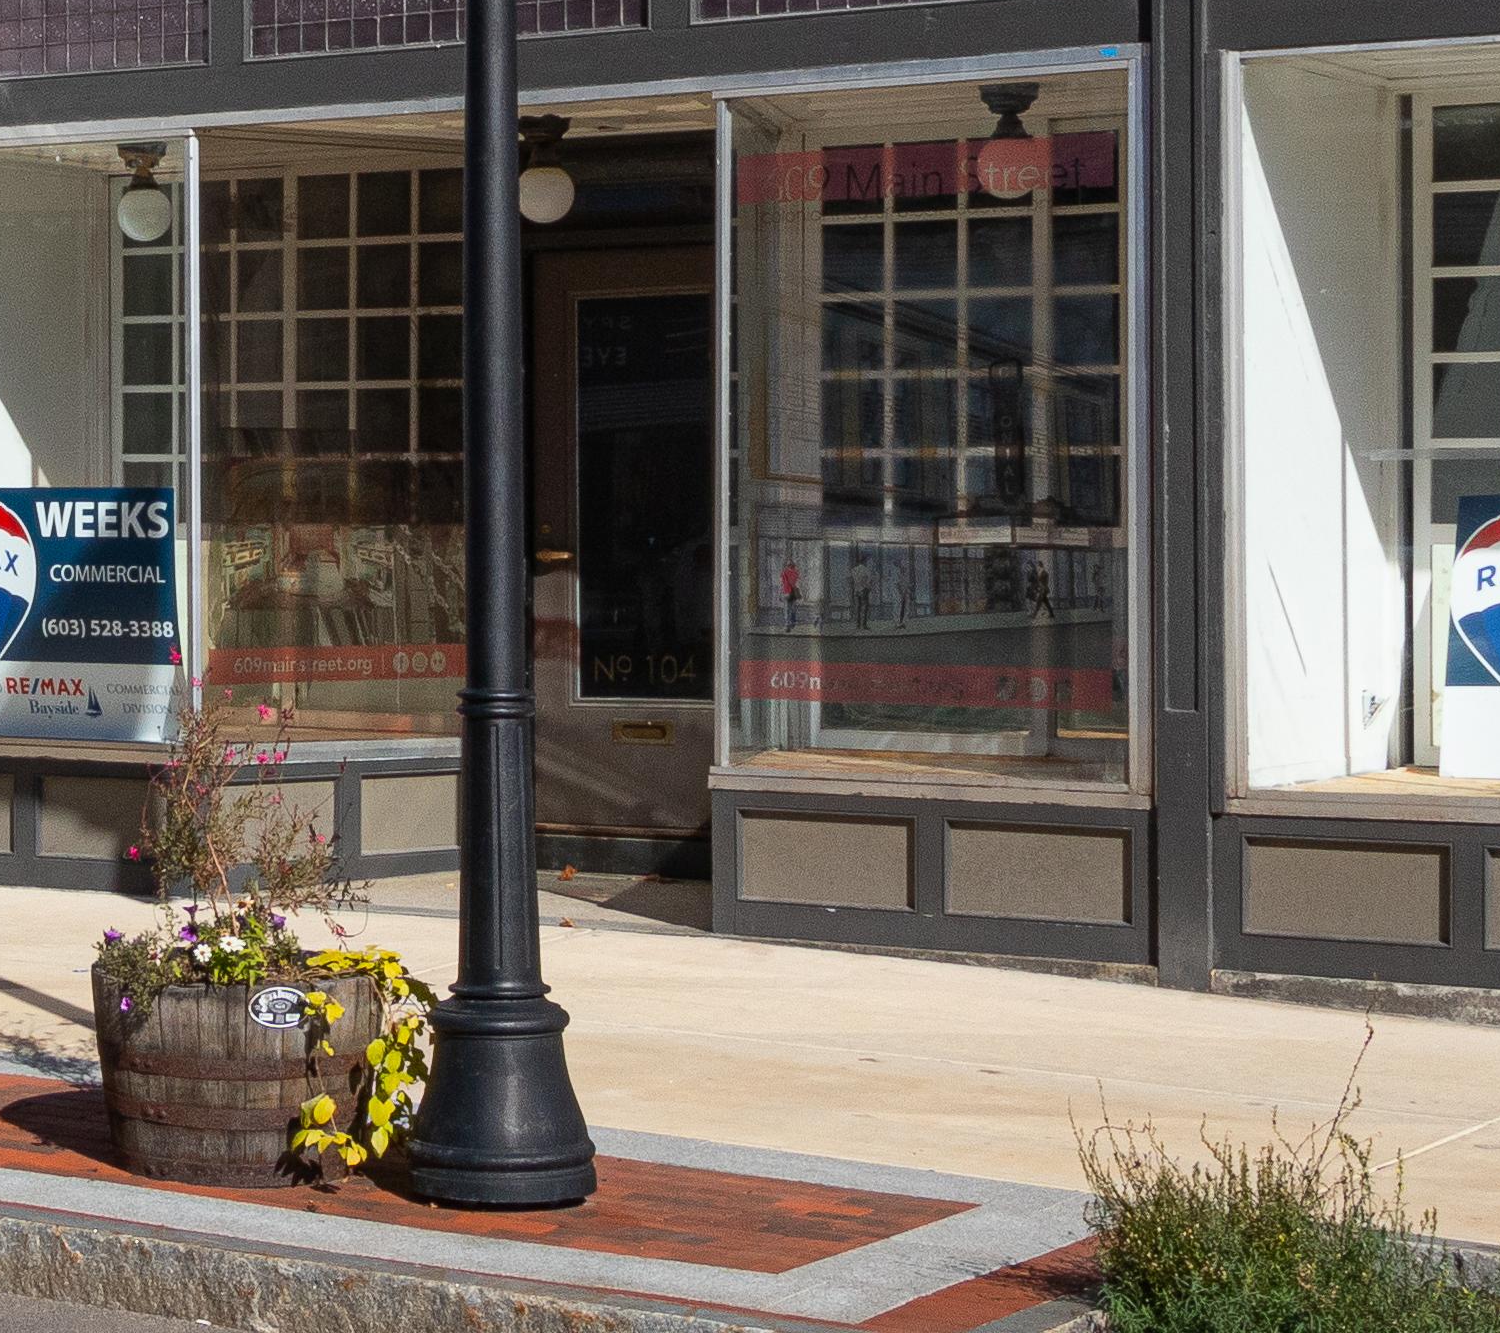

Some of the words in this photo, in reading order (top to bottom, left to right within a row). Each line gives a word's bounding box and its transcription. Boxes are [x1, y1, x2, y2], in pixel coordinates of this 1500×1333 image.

[35, 500, 169, 540] WEEKS
[49, 564, 166, 584] COMMERCIAL
[41, 617, 86, 639] (603)
[90, 619, 175, 638] 528-3388
[645, 653, 697, 684] 104
[5, 677, 85, 697] RE/MAX
[29, 699, 80, 719] Bayside
